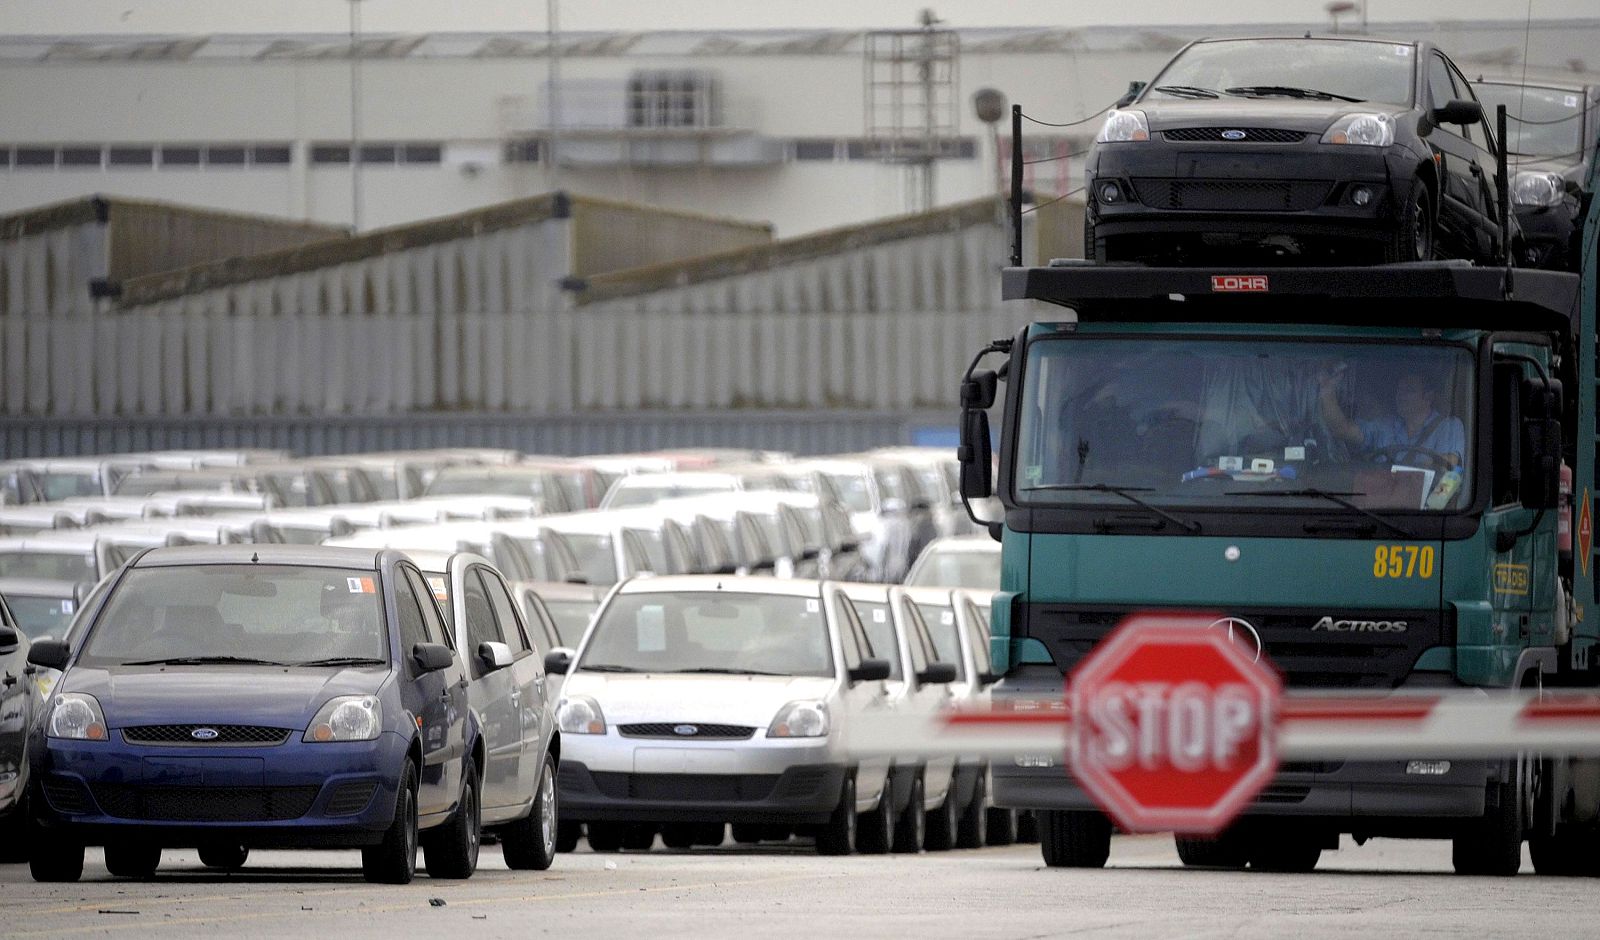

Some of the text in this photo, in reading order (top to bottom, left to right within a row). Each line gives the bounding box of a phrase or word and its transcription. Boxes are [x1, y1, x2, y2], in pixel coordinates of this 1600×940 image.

[1213, 278, 1266, 289] LOHR
[1373, 545, 1434, 578] 8570
[1090, 681, 1252, 770] STOP
